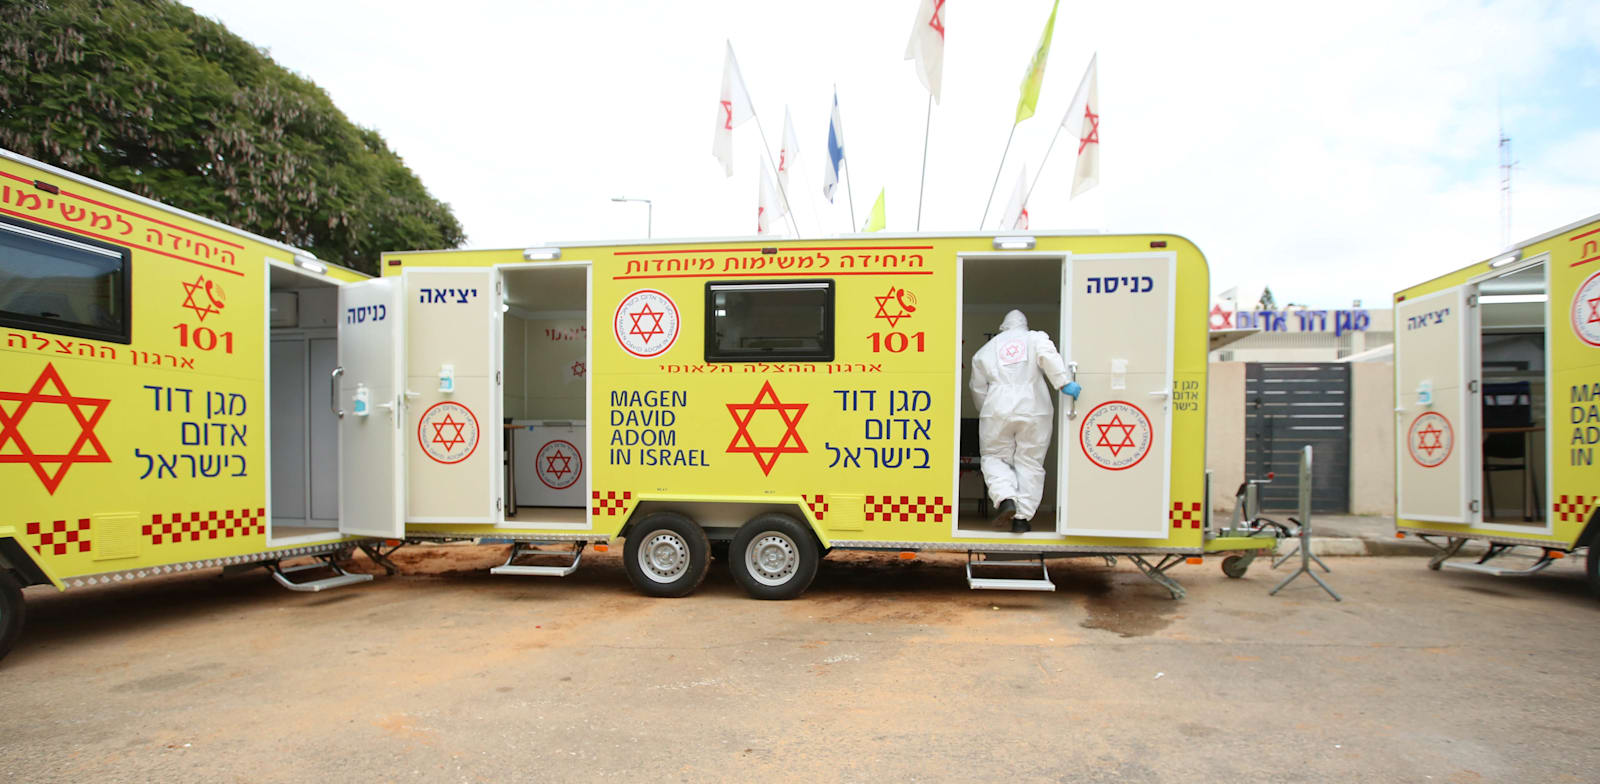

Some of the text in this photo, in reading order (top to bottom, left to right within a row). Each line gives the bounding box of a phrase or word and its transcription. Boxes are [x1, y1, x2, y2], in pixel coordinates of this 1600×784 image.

[2, 185, 236, 266] היחידה למשימו
[625, 252, 924, 275] היחידה למשימות מיוחדות
[1086, 275, 1154, 294] כניסה
[419, 288, 478, 304] יציאה
[347, 304, 387, 325] כניסה
[1236, 310, 1370, 337] מגן דוד אדום
[1407, 308, 1450, 330] יציאה
[173, 323, 233, 354] 101
[866, 331, 925, 353] 101
[8, 333, 195, 370] ארגון ההצלה
[660, 362, 882, 375] ארגון ההצלה הלאומי
[143, 385, 247, 419] מגן דוד
[610, 390, 687, 408] MAGEN
[833, 389, 932, 416] מגן דוד
[1571, 383, 1600, 403] MA
[1173, 402, 1198, 411] בישר
[1571, 405, 1600, 424] DA
[610, 409, 676, 427] DAVID
[181, 422, 247, 447] אדום
[610, 429, 676, 447] ADOM
[864, 418, 932, 441] אדום
[1571, 427, 1600, 445] AD
[135, 448, 247, 480] בישראל
[610, 448, 711, 467] IN ISRAEL
[825, 442, 931, 469] בישראל
[1571, 448, 1592, 466] IN
